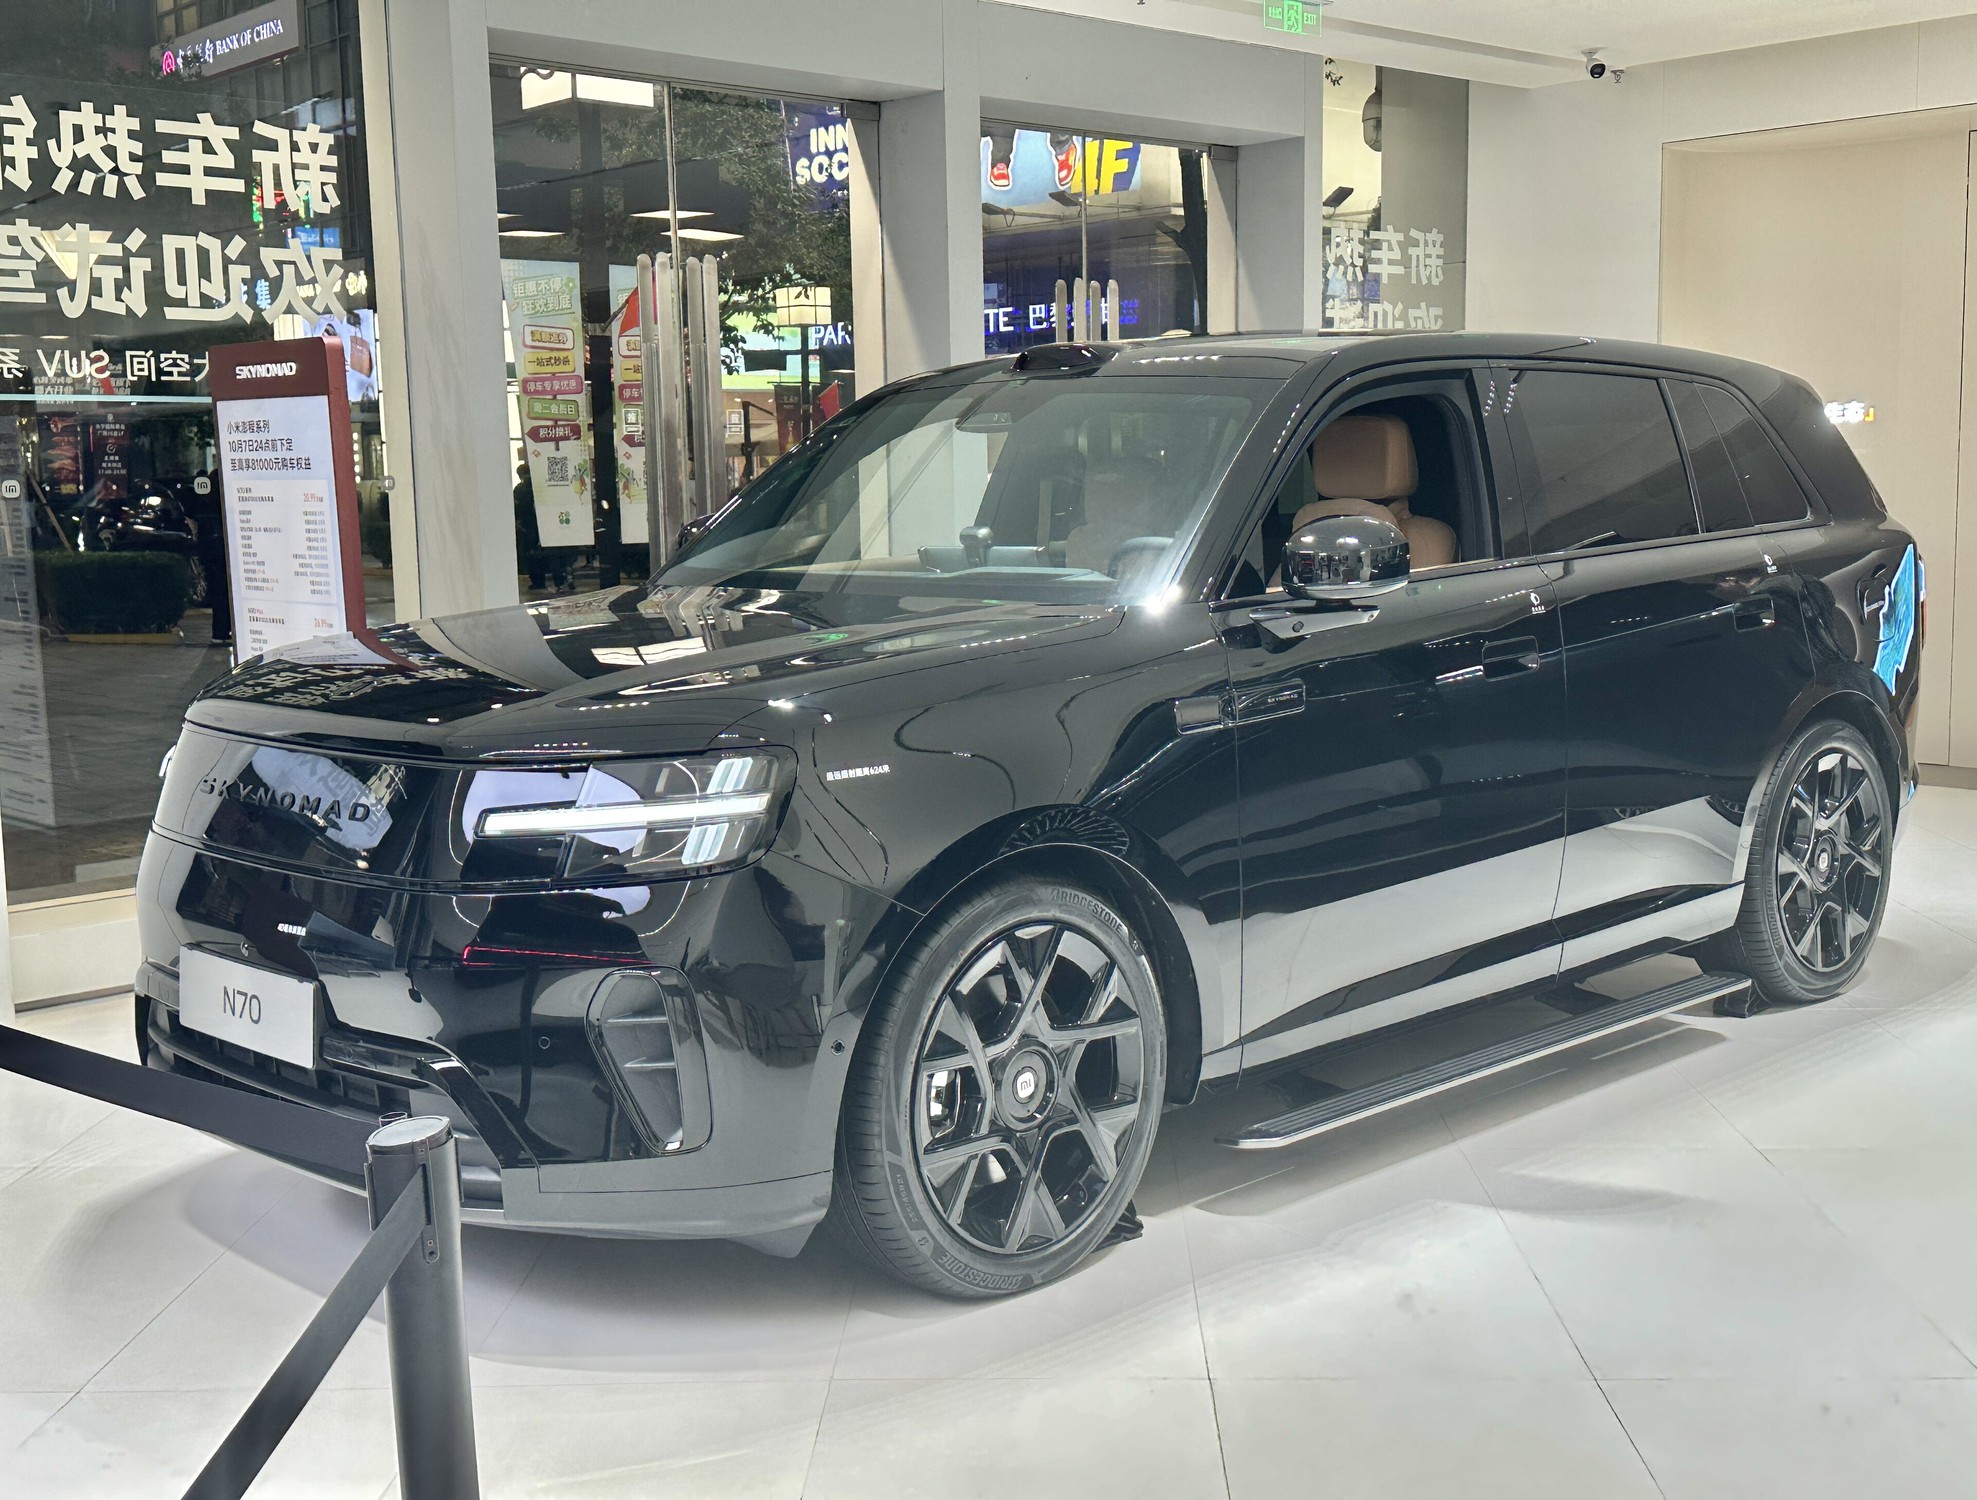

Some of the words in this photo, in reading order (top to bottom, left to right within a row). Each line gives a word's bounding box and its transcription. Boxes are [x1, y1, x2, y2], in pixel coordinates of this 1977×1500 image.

[215, 34, 240, 56] BANK
[240, 28, 253, 47] OF
[253, 19, 284, 43] CHINA
[236, 361, 297, 380] SKYNOMAD
[200, 777, 371, 822] SKYNOMAD
[1050, 887, 1125, 933] BRIDGESTONE
[222, 985, 262, 1025] N70
[937, 1251, 1023, 1290] BRIDGESTONE
